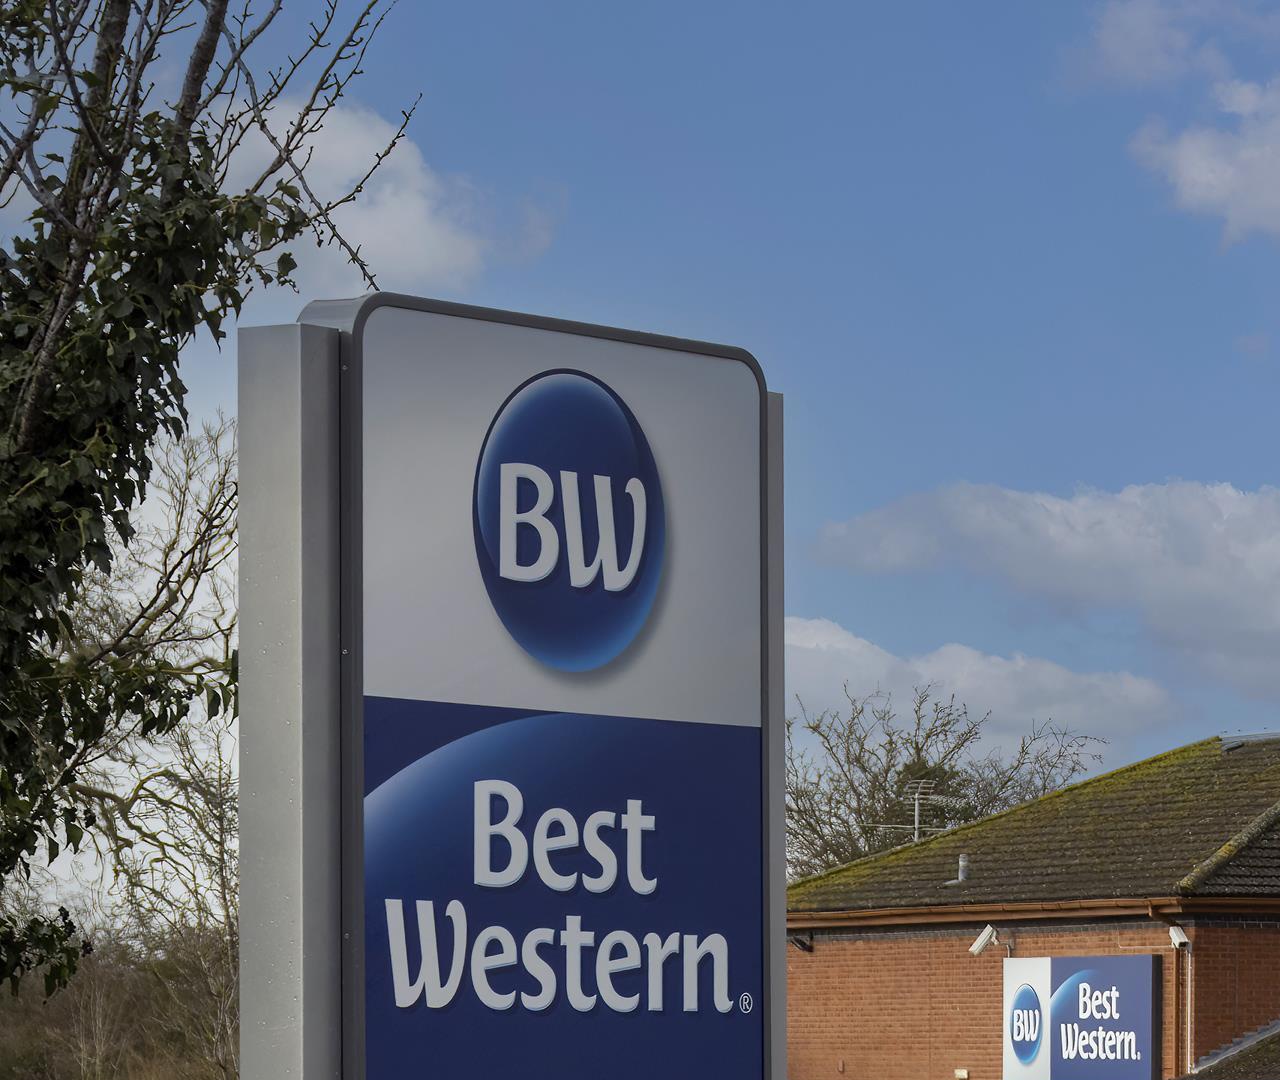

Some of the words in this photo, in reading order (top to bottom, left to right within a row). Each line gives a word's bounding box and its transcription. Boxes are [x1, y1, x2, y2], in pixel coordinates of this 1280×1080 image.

[497, 461, 649, 594] BW
[473, 779, 657, 895] Best
[1012, 1008, 1040, 1042] BW
[1078, 982, 1120, 1020] Best
